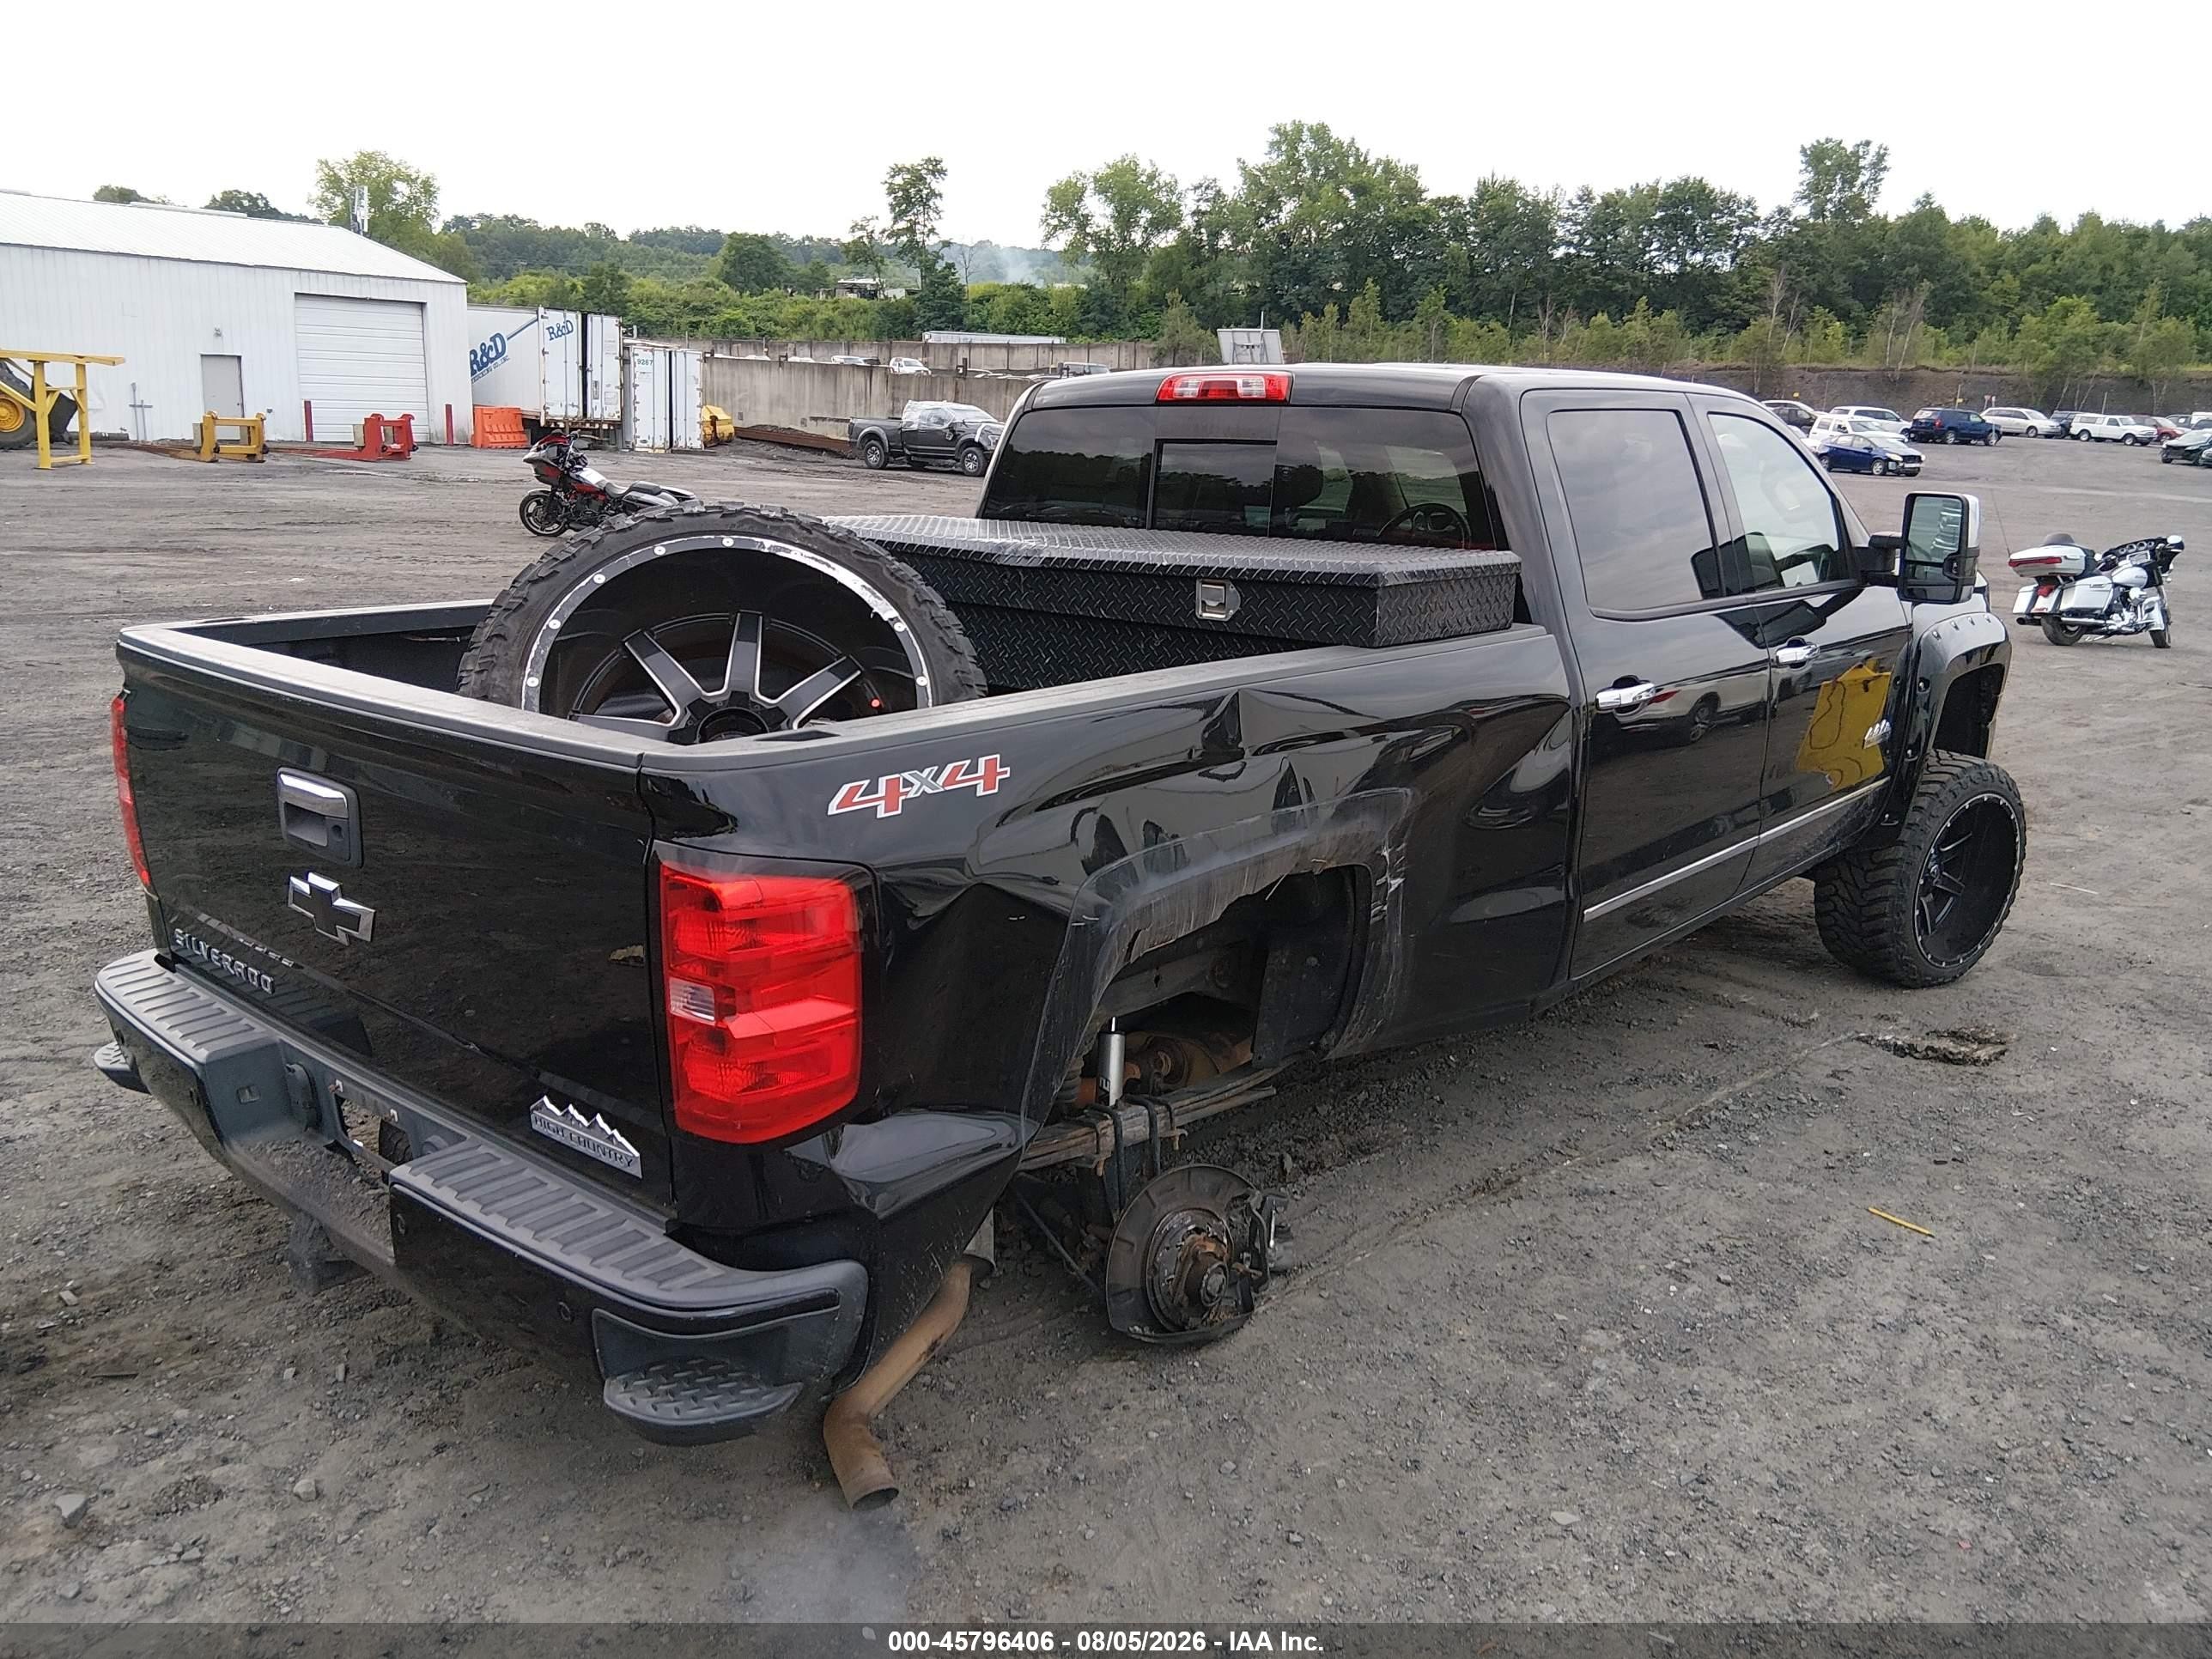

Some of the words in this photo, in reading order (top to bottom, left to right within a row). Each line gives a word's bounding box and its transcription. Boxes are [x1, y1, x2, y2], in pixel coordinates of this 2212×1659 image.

[469, 332, 507, 377] R&D
[545, 319, 574, 341] R&D
[174, 928, 275, 994] SILVERADO
[534, 1115, 566, 1139] HIGH
[568, 1132, 634, 1170] COUNTRY
